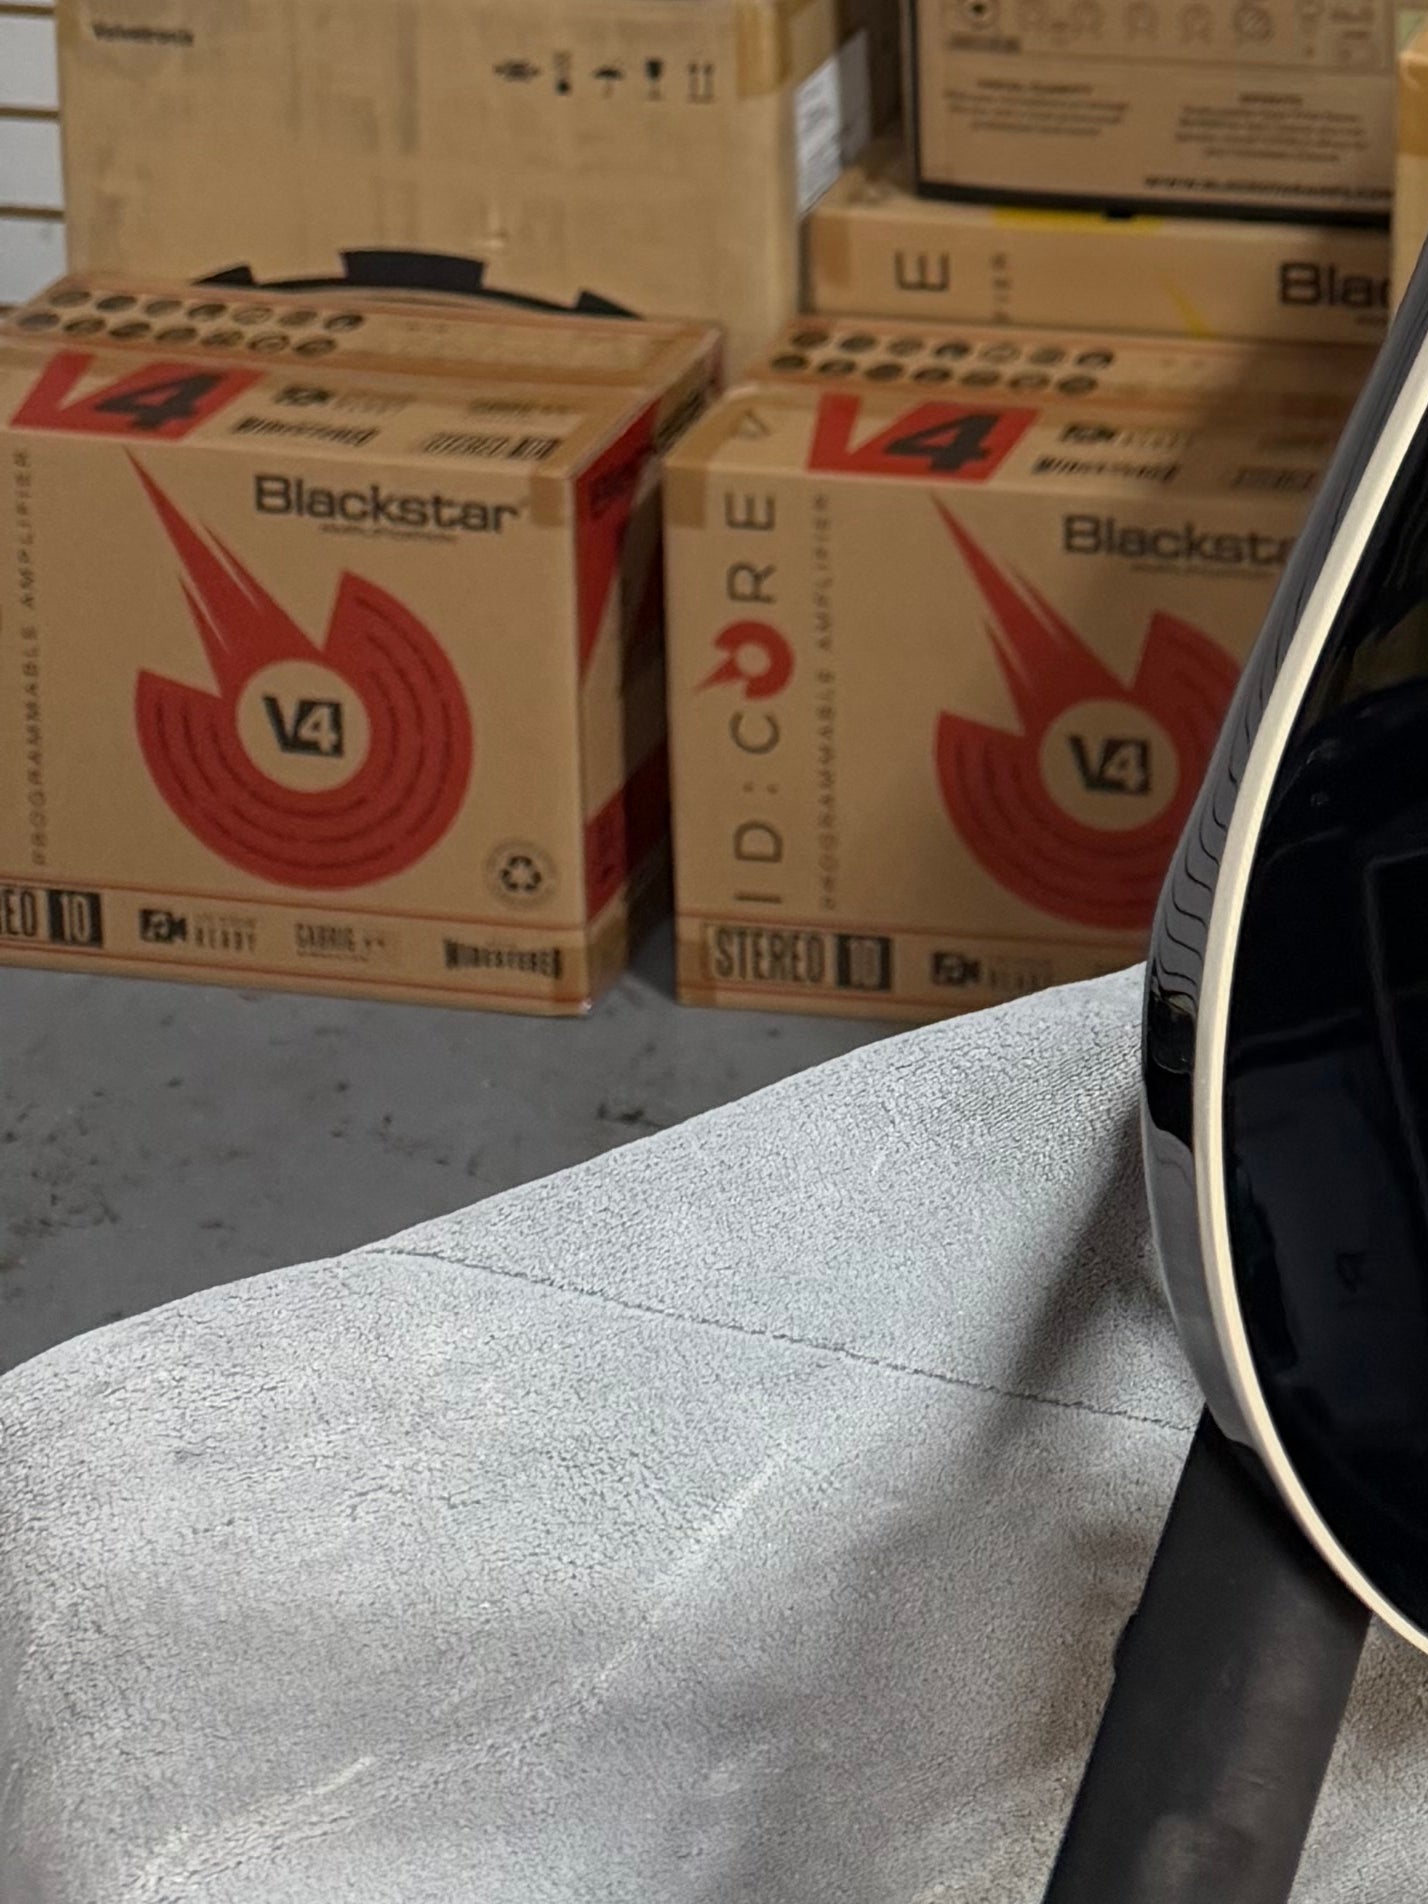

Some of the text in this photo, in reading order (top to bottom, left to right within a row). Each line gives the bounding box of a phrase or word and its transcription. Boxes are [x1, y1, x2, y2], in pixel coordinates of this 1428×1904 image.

[253, 473, 520, 534] Blackstar
[262, 694, 345, 759] V4
[1067, 734, 1152, 795] V4
[713, 925, 826, 984] STEREO
